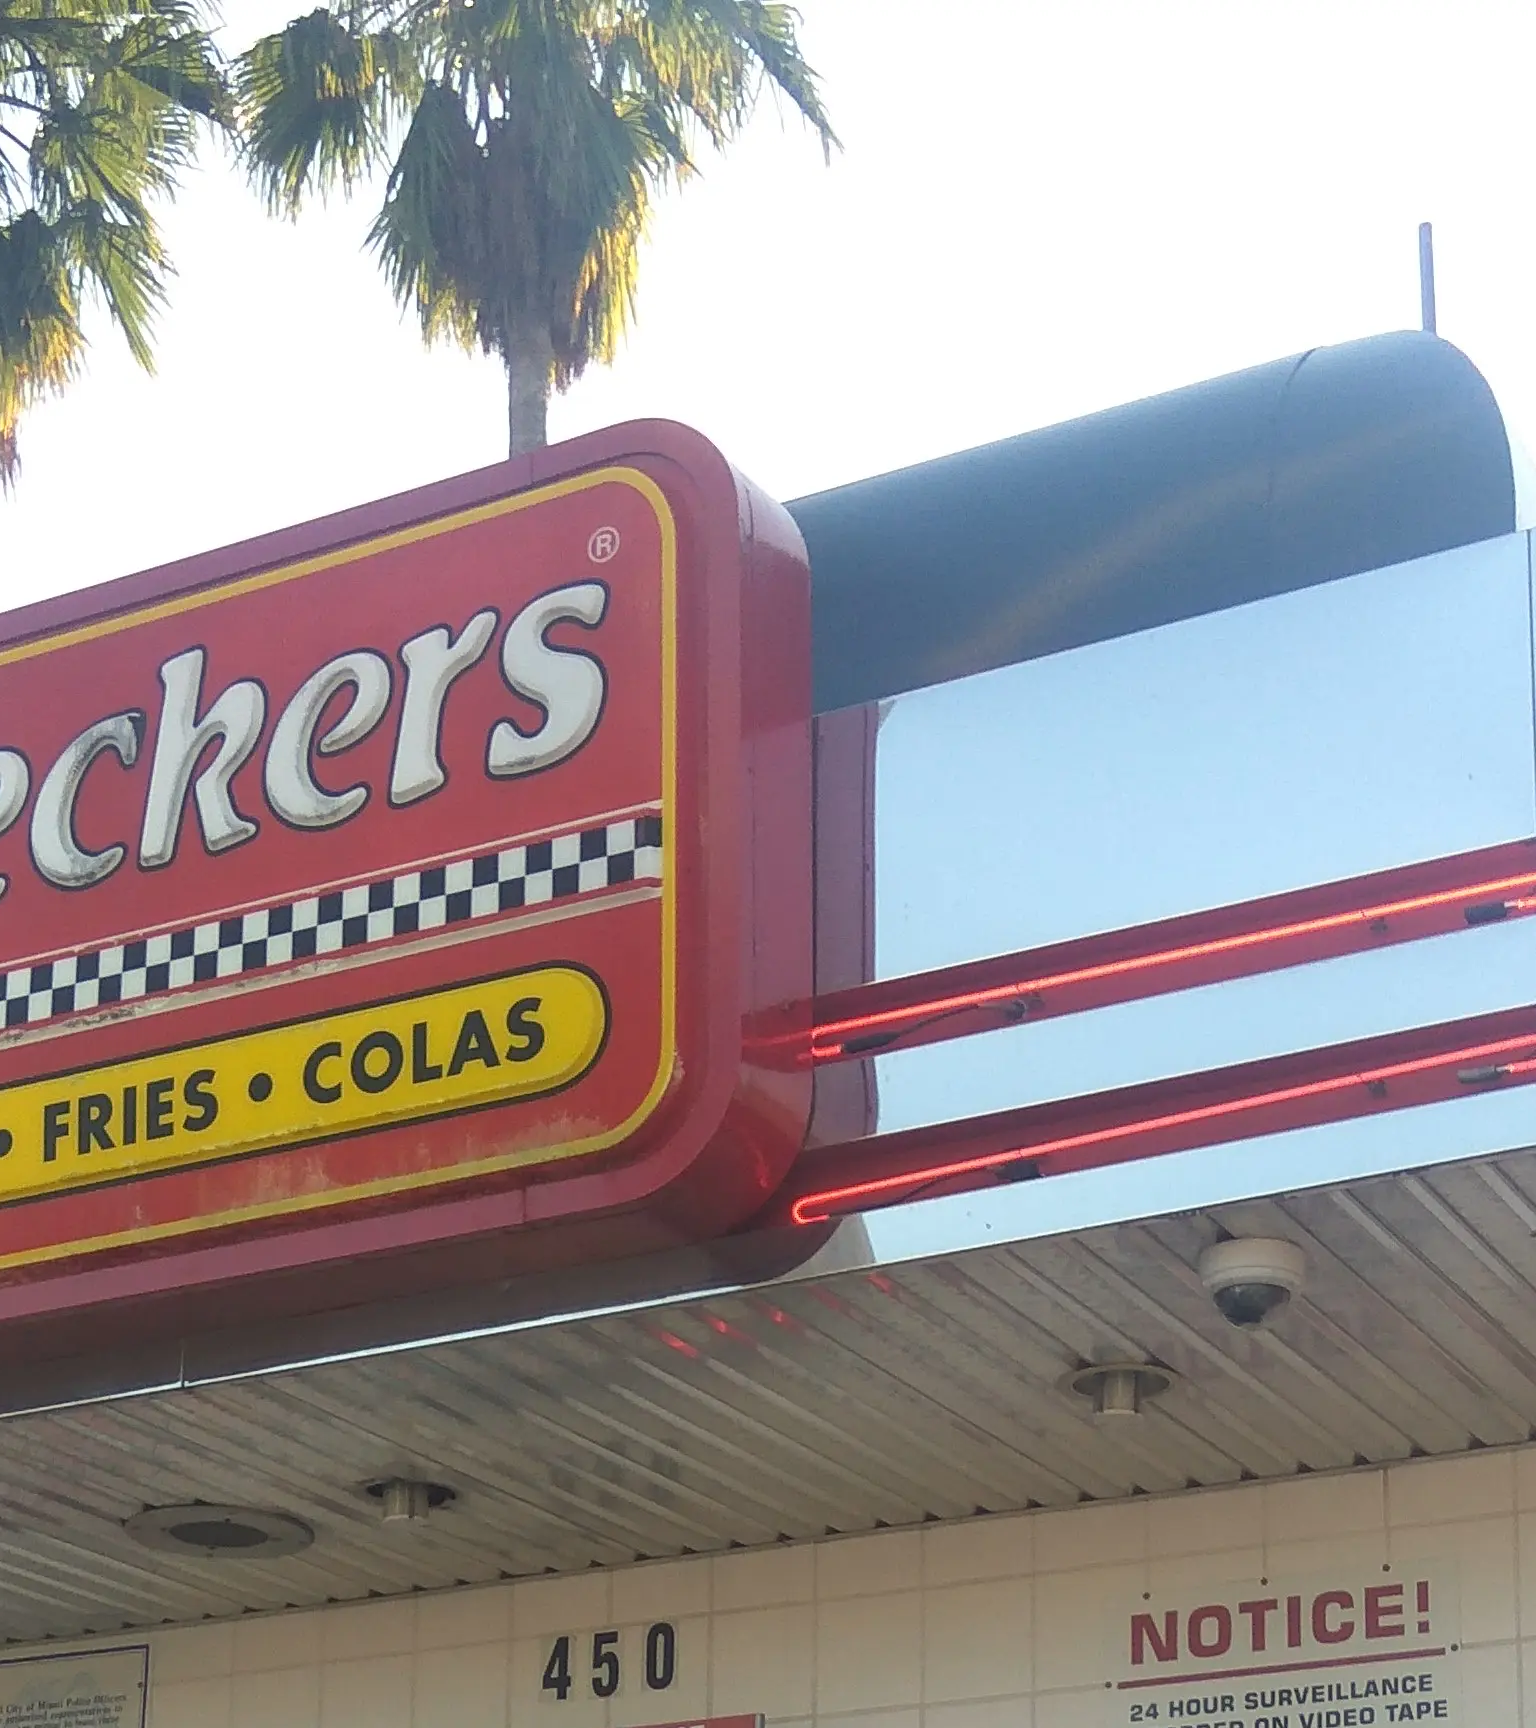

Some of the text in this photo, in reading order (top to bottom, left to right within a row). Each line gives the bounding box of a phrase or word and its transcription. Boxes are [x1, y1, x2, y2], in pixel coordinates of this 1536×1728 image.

[43, 1069, 220, 1164] FRIES
[303, 997, 545, 1104] COLAS
[542, 1622, 675, 1700] 450
[1130, 1581, 1430, 1665] NOTICE!
[1130, 1674, 1433, 1722] 24 HOUR SURVEILLANCE
[1385, 1699, 1448, 1722] TAPE
